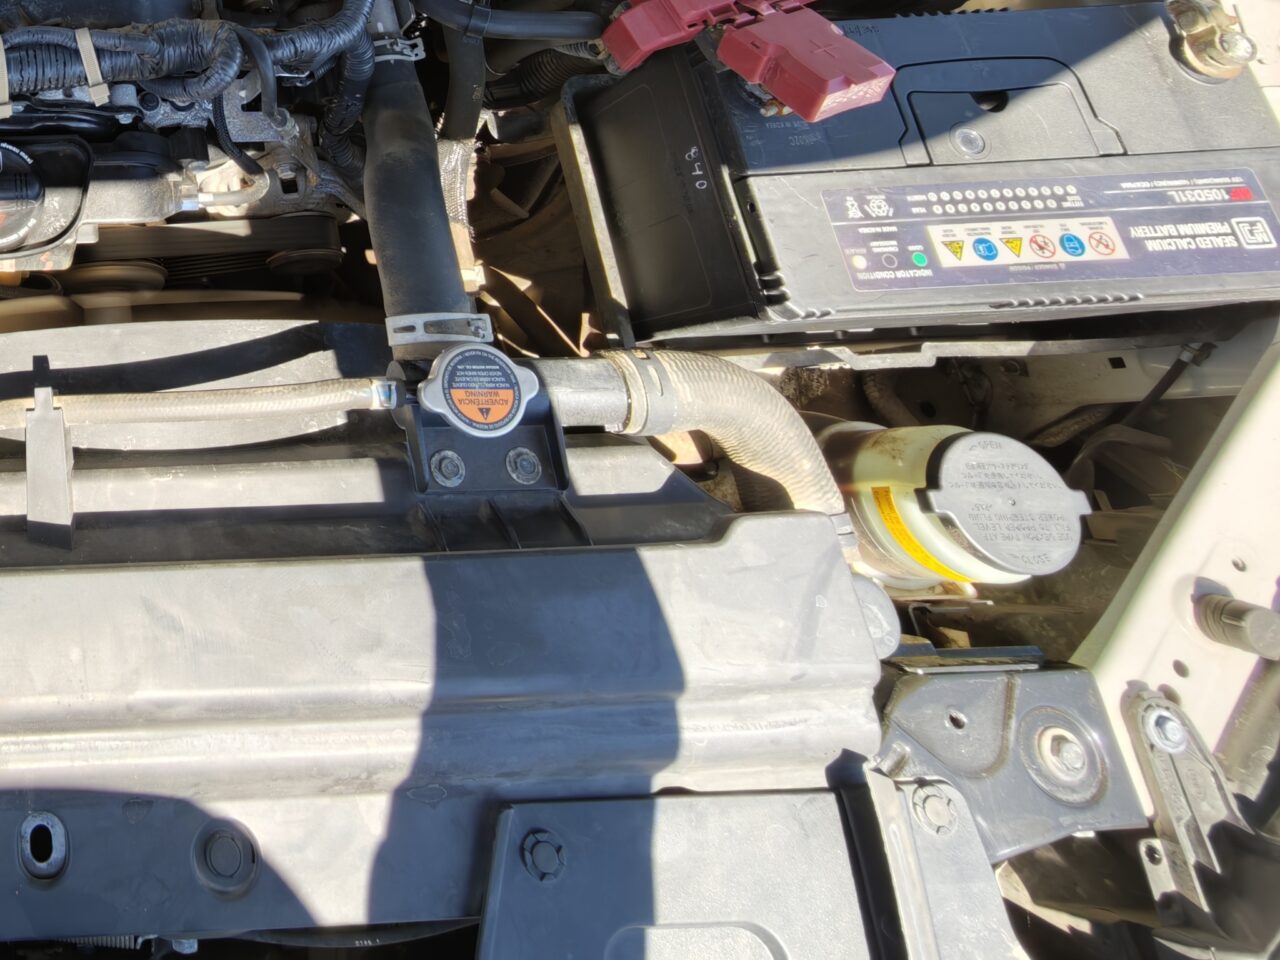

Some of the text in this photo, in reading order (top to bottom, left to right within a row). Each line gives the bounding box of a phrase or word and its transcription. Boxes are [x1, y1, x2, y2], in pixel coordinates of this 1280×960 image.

[1166, 189, 1231, 203] 105D31L
[1129, 222, 1232, 238] PREMIUM BATTERY
[1144, 236, 1239, 252] SEALED CALCIUM
[856, 269, 933, 280] INDICATOR CONDITION
[994, 513, 1034, 521] STEERING
[1037, 513, 1064, 521] POWER
[971, 522, 1002, 531] LEVEL
